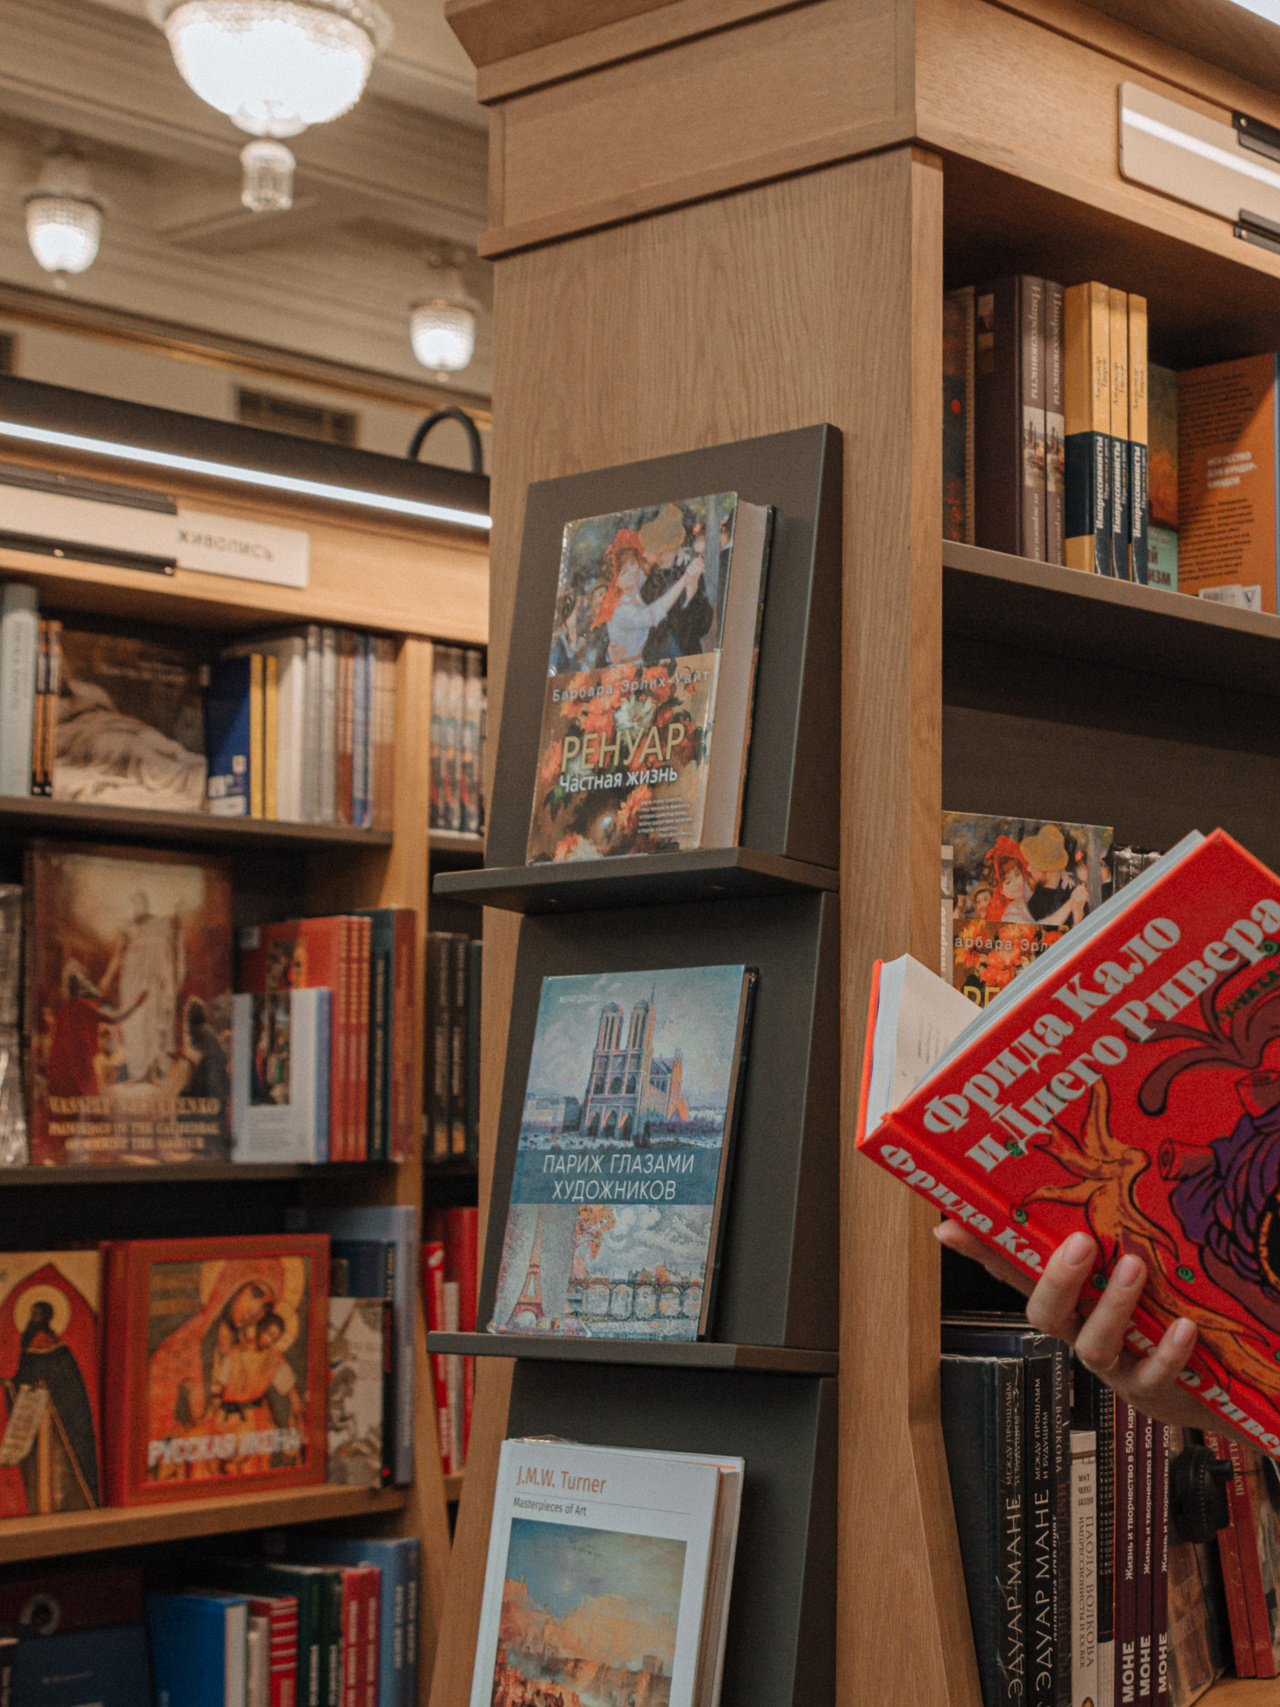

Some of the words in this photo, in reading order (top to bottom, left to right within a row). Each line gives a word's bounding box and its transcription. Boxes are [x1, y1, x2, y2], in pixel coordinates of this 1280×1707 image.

[552, 684, 614, 702] Барбара
[561, 722, 686, 772] РЕНУАР
[559, 771, 623, 793] Частная
[626, 767, 678, 786] жизнь
[955, 936, 1012, 951] арбара
[923, 1013, 1074, 1135] Фрида
[1052, 916, 1182, 1024] Кало
[964, 1134, 1013, 1174] и
[990, 1034, 1129, 1158] Диего
[542, 1153, 604, 1175] ПАРИЖ
[609, 1153, 695, 1174] ГЛАЗАМИ
[551, 1179, 677, 1202] ХУДОЖНИКОВ
[880, 1144, 994, 1234] Фрида
[992, 1226, 1044, 1273] Ка
[1055, 1351, 1063, 1400] ПАОЛА
[1055, 1406, 1063, 1473] ВОЛКОВА
[1126, 1430, 1135, 1454] 500
[1145, 1425, 1153, 1449] 500
[512, 1497, 563, 1514] Masterpieces
[564, 1503, 574, 1516] of
[574, 1505, 587, 1517] Art
[515, 1465, 556, 1489] J.M.W.
[560, 1471, 607, 1495] Turner
[1127, 1464, 1135, 1534] творчество
[1006, 1494, 1022, 1585] МАНЕ
[1035, 1489, 1050, 1579] МАНЕ
[1085, 1516, 1094, 1577] ПАОЛА
[1125, 1541, 1134, 1581] Жизнь
[1143, 1540, 1151, 1575] Жизнь
[1007, 1595, 1024, 1698] ЭДУАР
[1036, 1590, 1053, 1691] ЭДУАР
[1086, 1583, 1095, 1668] ВОЛКОВА
[1122, 1641, 1135, 1703] МОНЕ
[1140, 1635, 1151, 1696] МОНЕ
[1158, 1632, 1167, 1693] МОНЕ
